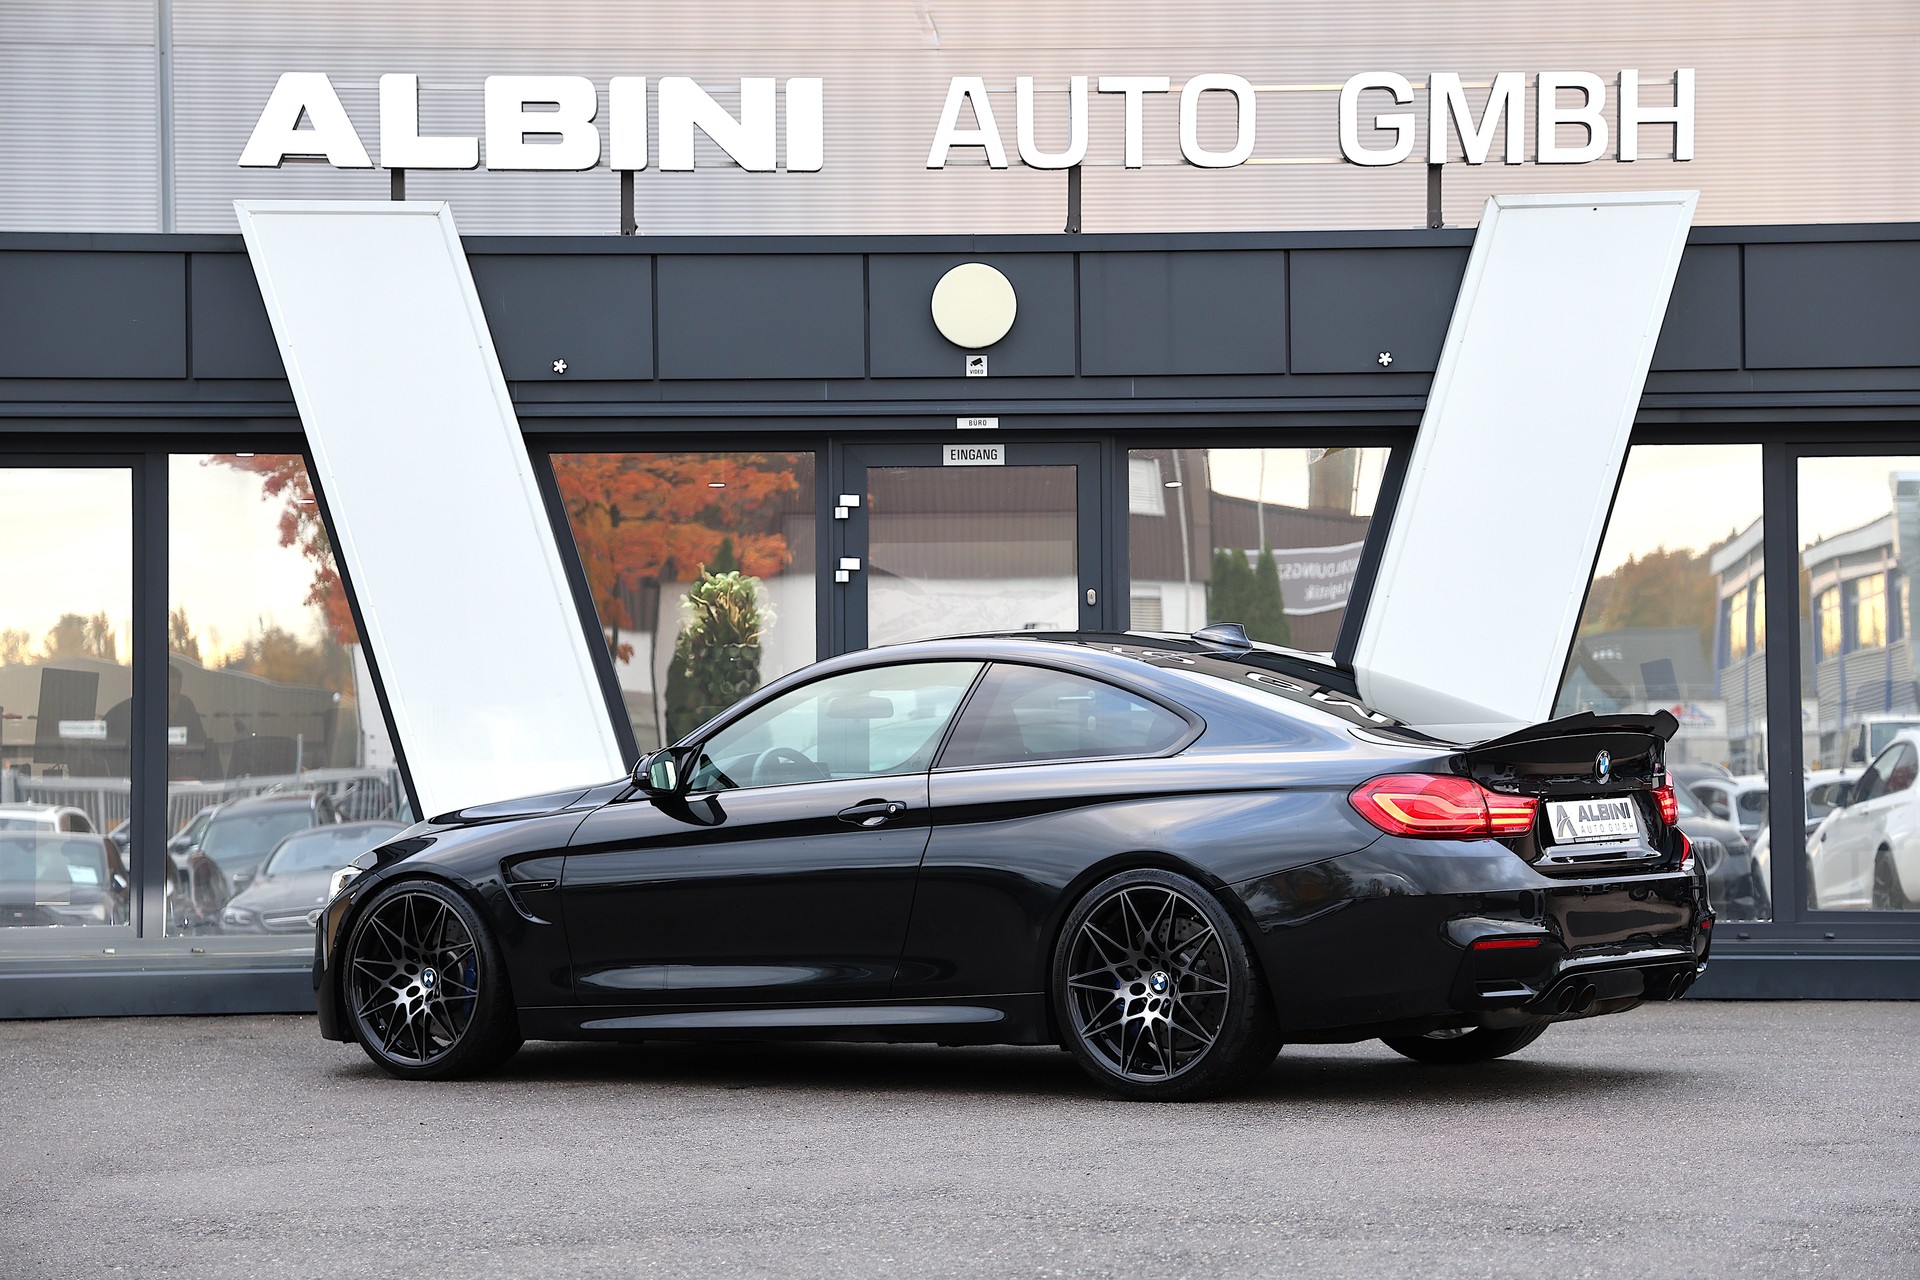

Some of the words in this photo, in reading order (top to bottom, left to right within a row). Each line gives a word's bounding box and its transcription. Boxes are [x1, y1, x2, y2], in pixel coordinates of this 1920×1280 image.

[236, 71, 824, 172] ALBINI
[925, 73, 1258, 169] AUTO
[1337, 67, 1696, 167] GMBH
[968, 418, 987, 426] BÜRO
[950, 448, 998, 460] EINGANG
[1578, 802, 1631, 822] ALBINI
[1581, 823, 1605, 834] AUTO
[1608, 822, 1634, 832] GMBH
